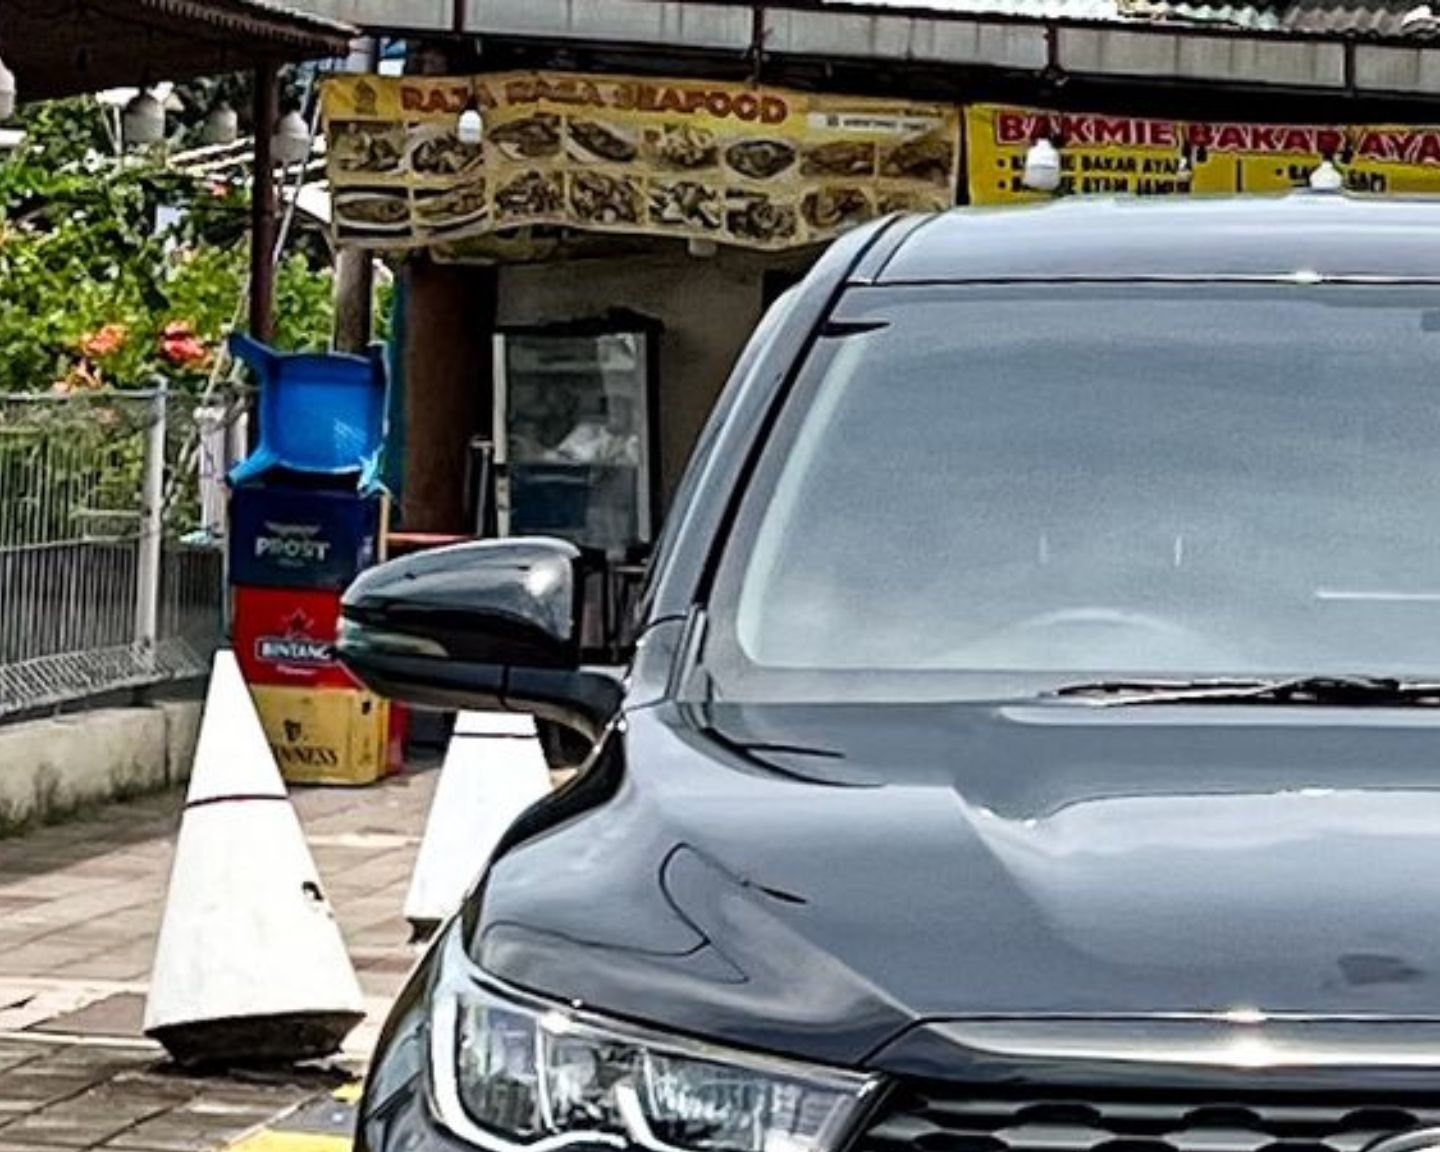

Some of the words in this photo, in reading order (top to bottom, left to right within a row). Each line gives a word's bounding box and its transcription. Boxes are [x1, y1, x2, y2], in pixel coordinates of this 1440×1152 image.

[611, 83, 788, 125] SEAFOOD
[998, 114, 1174, 146] BAKMIE
[1189, 123, 1343, 153] BAKAR
